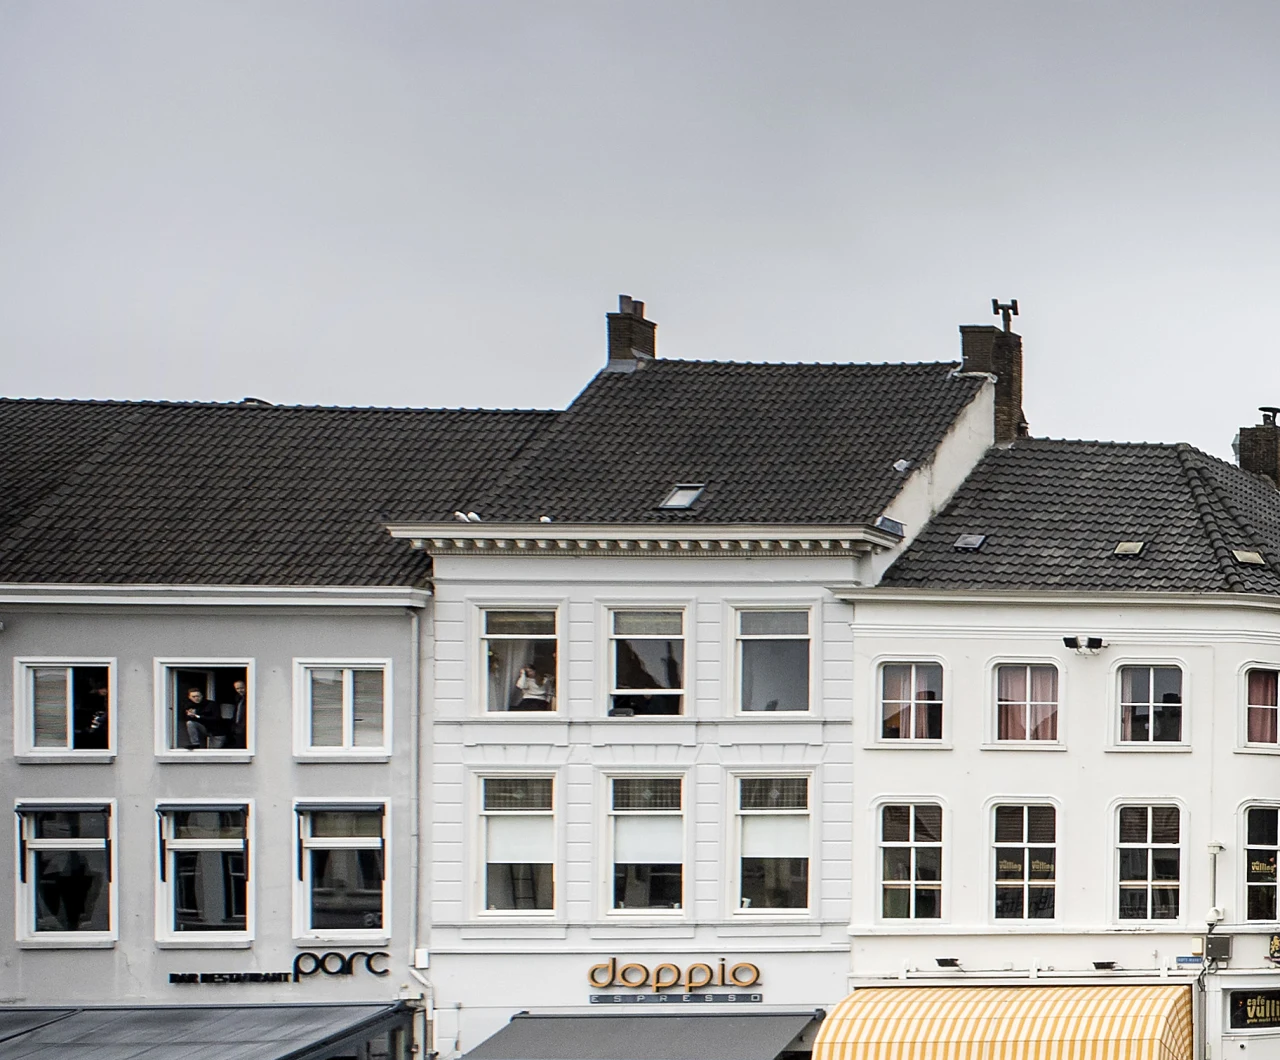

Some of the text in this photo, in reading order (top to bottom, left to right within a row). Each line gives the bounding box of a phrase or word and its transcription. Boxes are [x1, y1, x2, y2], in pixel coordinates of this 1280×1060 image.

[293, 951, 390, 983] parc
[587, 957, 761, 993] doppio
[591, 994, 760, 1003] ESPRESSO
[1247, 996, 1265, 1006] café
